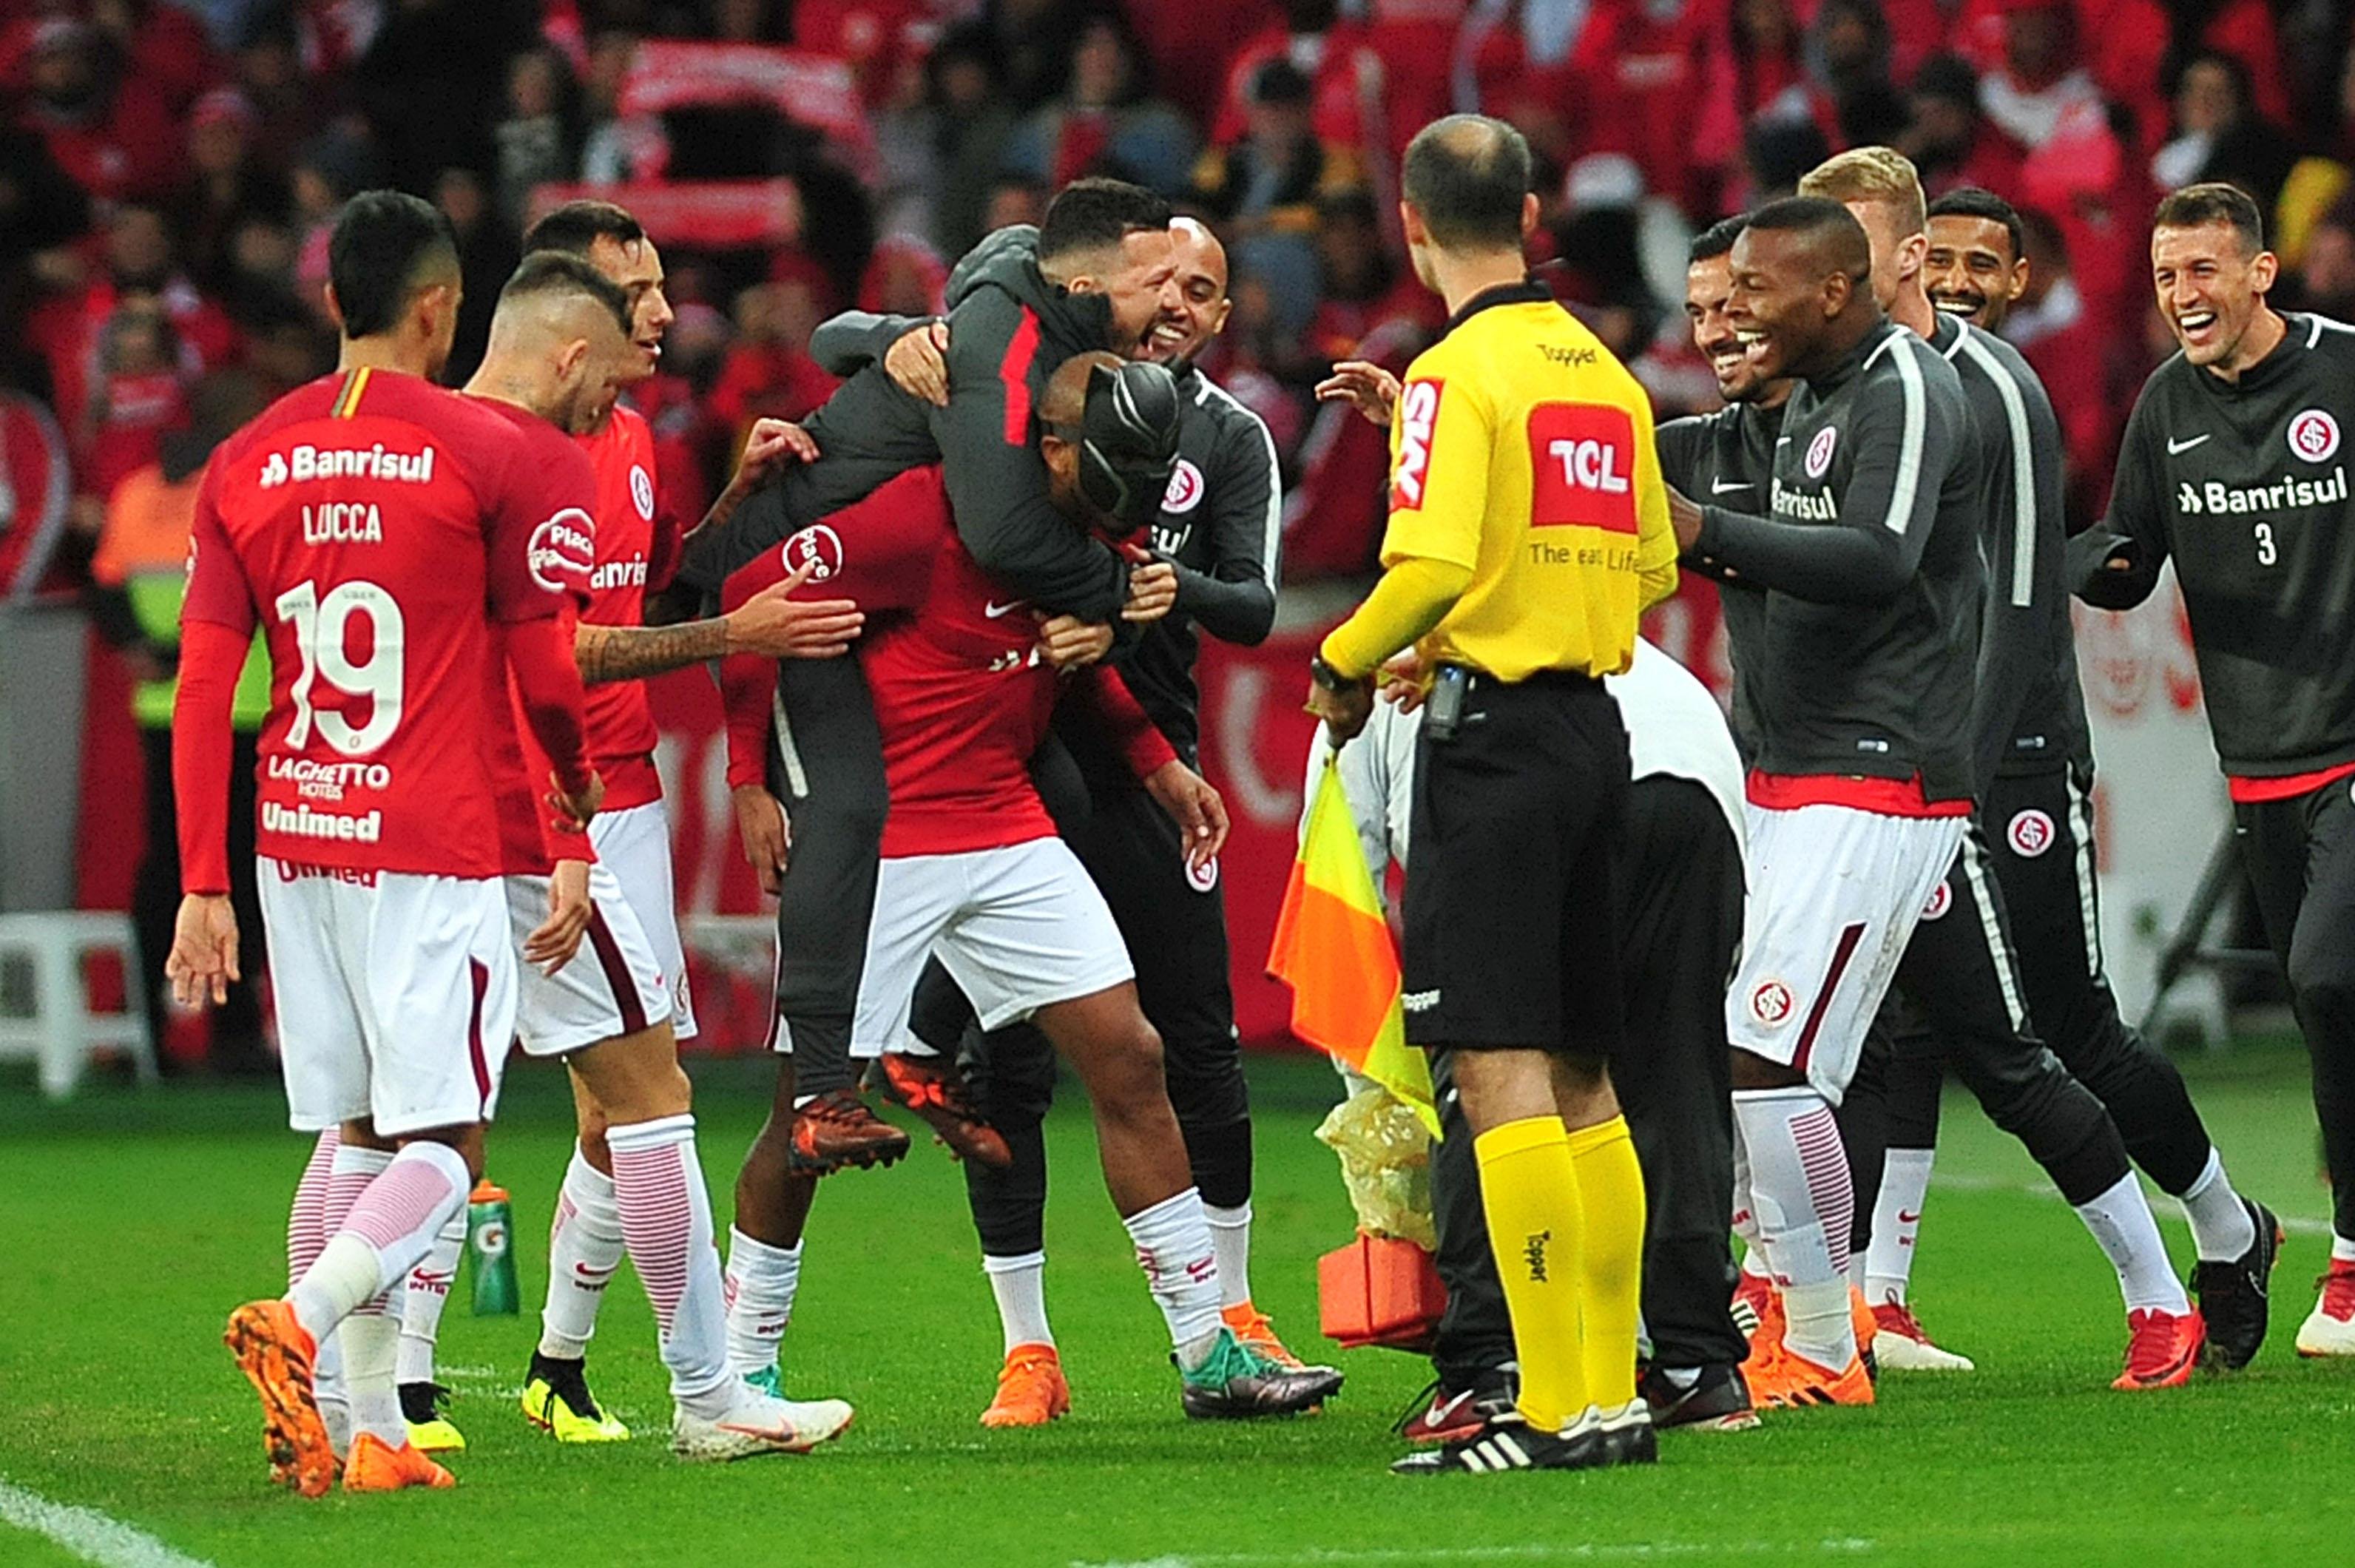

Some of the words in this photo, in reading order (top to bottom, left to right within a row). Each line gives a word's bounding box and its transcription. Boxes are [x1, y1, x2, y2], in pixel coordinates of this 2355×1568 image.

[291, 443, 435, 484] Banrisul
[1549, 439, 1629, 494] TCL
[2204, 466, 2348, 514] Banrisul
[302, 502, 383, 546] LUCCA
[2255, 522, 2277, 566] 3
[1530, 542, 1570, 564] The
[274, 579, 405, 757] 19
[262, 801, 382, 843] Unimed
